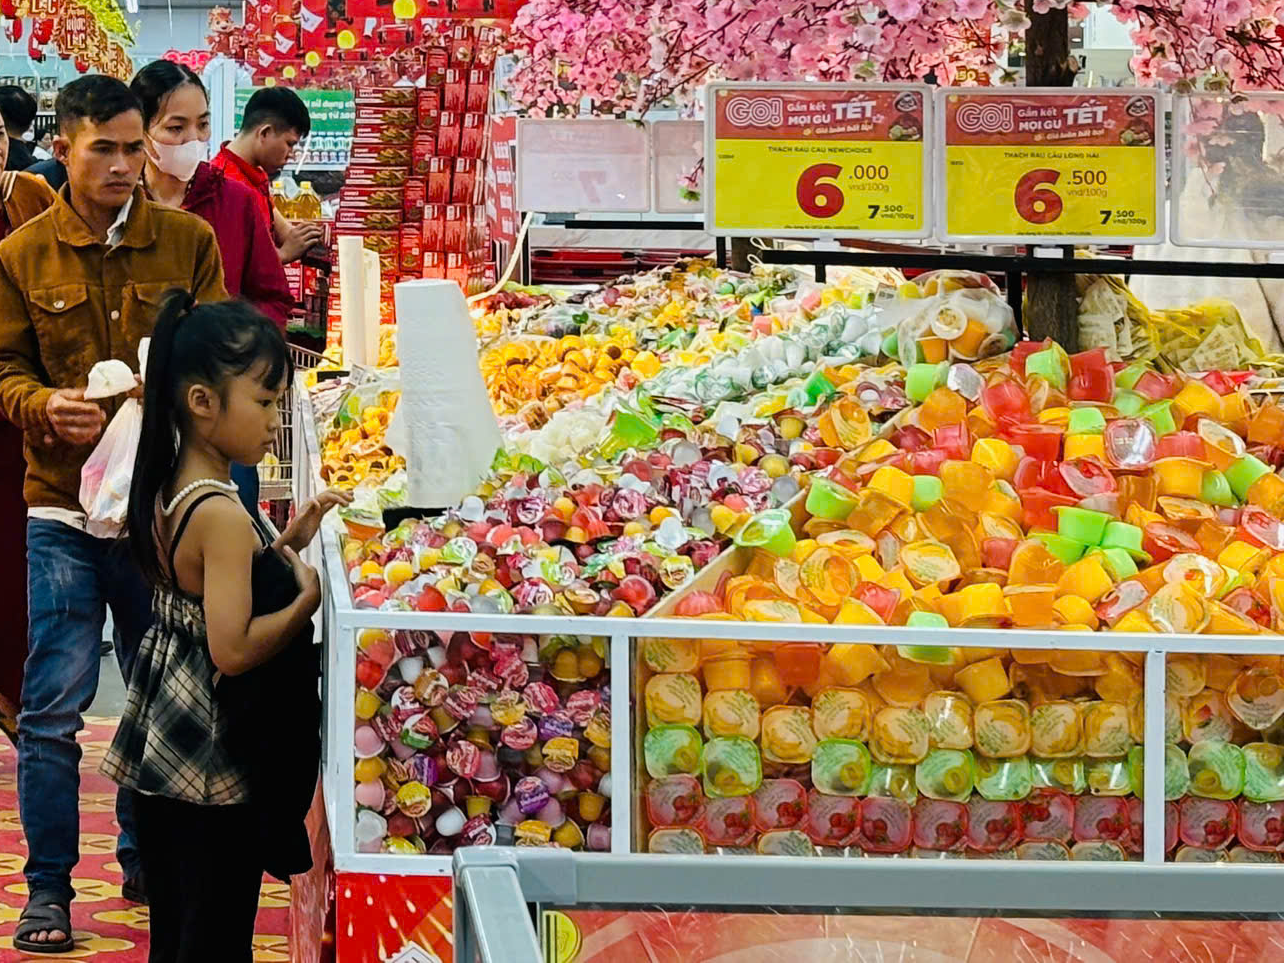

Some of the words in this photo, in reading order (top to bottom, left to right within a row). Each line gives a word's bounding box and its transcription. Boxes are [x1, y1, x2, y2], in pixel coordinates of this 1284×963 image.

[726, 96, 783, 127] GO!
[832, 94, 876, 121] TẾT
[956, 102, 1013, 133] GO!
[1063, 99, 1108, 125] TẾT
[812, 114, 831, 125] GU
[1043, 119, 1062, 130] GU
[796, 163, 844, 219] 6
[1015, 169, 1063, 224] 6
[1067, 170, 1107, 185] .500
[1067, 188, 1108, 198] vnd/100g
[868, 205, 880, 219] 7
[1100, 210, 1112, 225] 7
